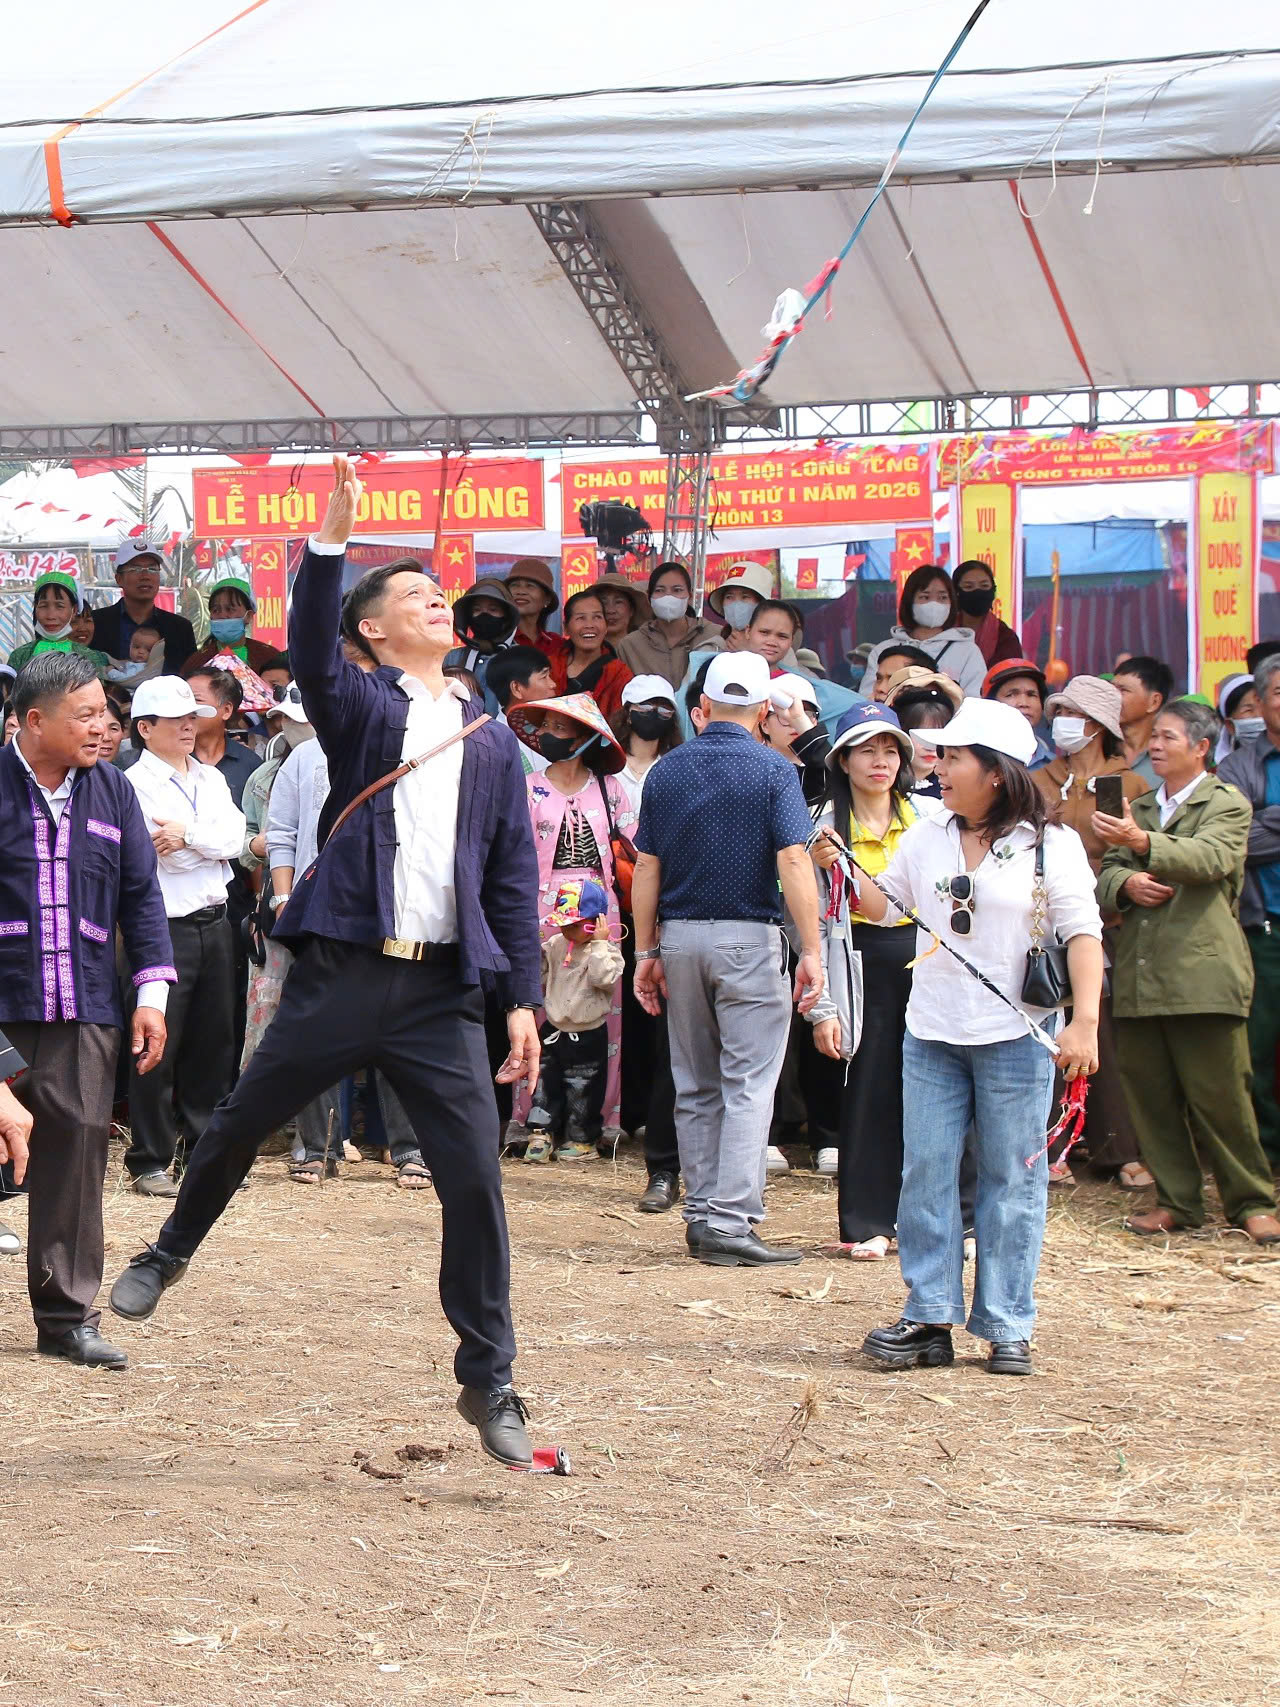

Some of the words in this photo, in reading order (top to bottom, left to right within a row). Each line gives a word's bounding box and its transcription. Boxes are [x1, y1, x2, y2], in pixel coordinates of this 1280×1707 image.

[574, 469, 632, 489] CHÀO
[713, 461, 738, 481] LỄ
[746, 461, 784, 481] HỘI
[207, 484, 247, 526] LỄ
[258, 485, 317, 530] HỘI
[329, 480, 422, 522] ỒNG
[432, 477, 529, 520] TỒNG
[739, 485, 784, 505] THỨ
[789, 487, 796, 503] I
[803, 483, 857, 502] NĂM
[864, 482, 921, 499] 2026
[707, 509, 754, 526] THÔN
[761, 509, 784, 523] 13
[976, 508, 996, 533] VUI
[256, 587, 282, 628] BẢN
